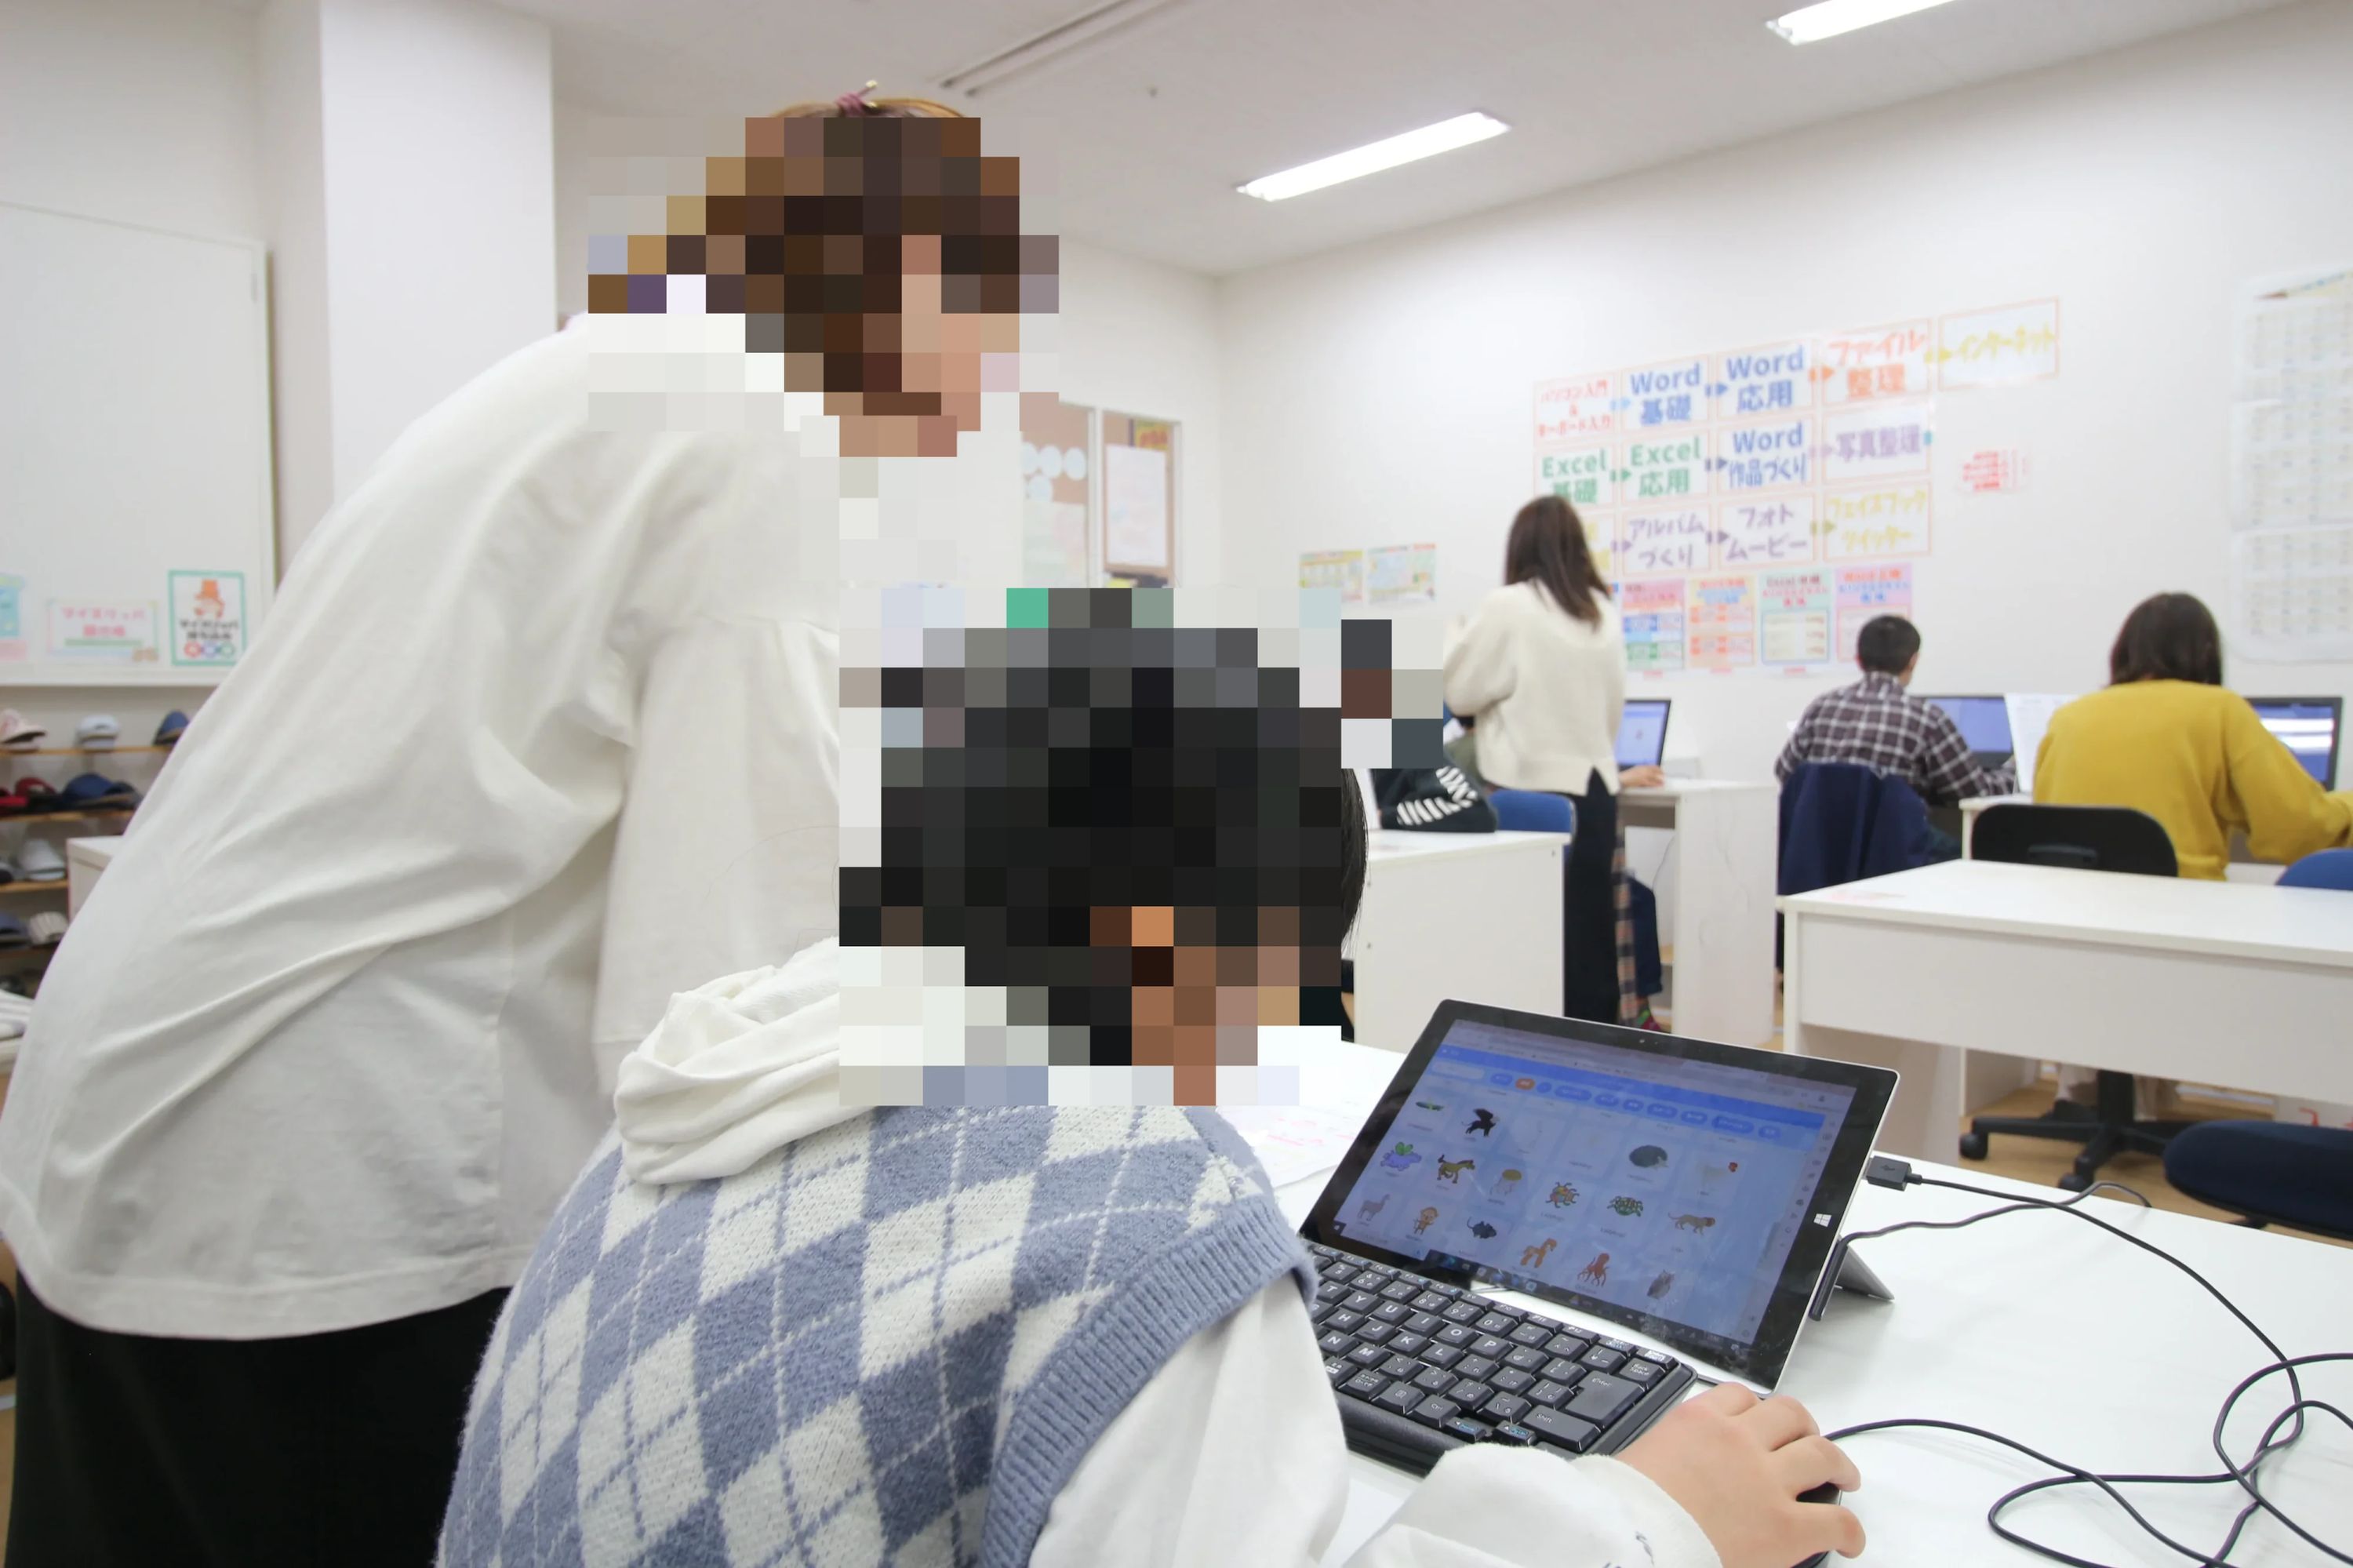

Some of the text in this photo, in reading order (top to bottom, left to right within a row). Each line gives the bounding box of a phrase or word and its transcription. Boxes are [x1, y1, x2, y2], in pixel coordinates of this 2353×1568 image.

[1828, 328, 1927, 366] ファイル
[1726, 344, 1803, 381] Word
[1630, 362, 1701, 396] Word
[1639, 394, 1692, 427] 基礎
[1737, 379, 1793, 414] 応用
[1630, 435, 1701, 467] Excel
[1732, 422, 1803, 454] Word
[1835, 424, 1921, 463] 写真整理
[1542, 449, 1606, 478] Excel
[1727, 453, 1806, 489] 作品づくり
[1638, 467, 1690, 497] 応用
[1628, 513, 1707, 541] アルバム
[1737, 502, 1795, 528] フォト
[1638, 543, 1694, 569] づくり
[1726, 532, 1807, 561] ムービー
[1355, 1295, 1367, 1304] Y
[1327, 1336, 1341, 1344] N
[1358, 1348, 1374, 1356] M
[1401, 1336, 1413, 1344] K
[1431, 1402, 1444, 1411] Ctrl
[1536, 1413, 1555, 1424] Shift
